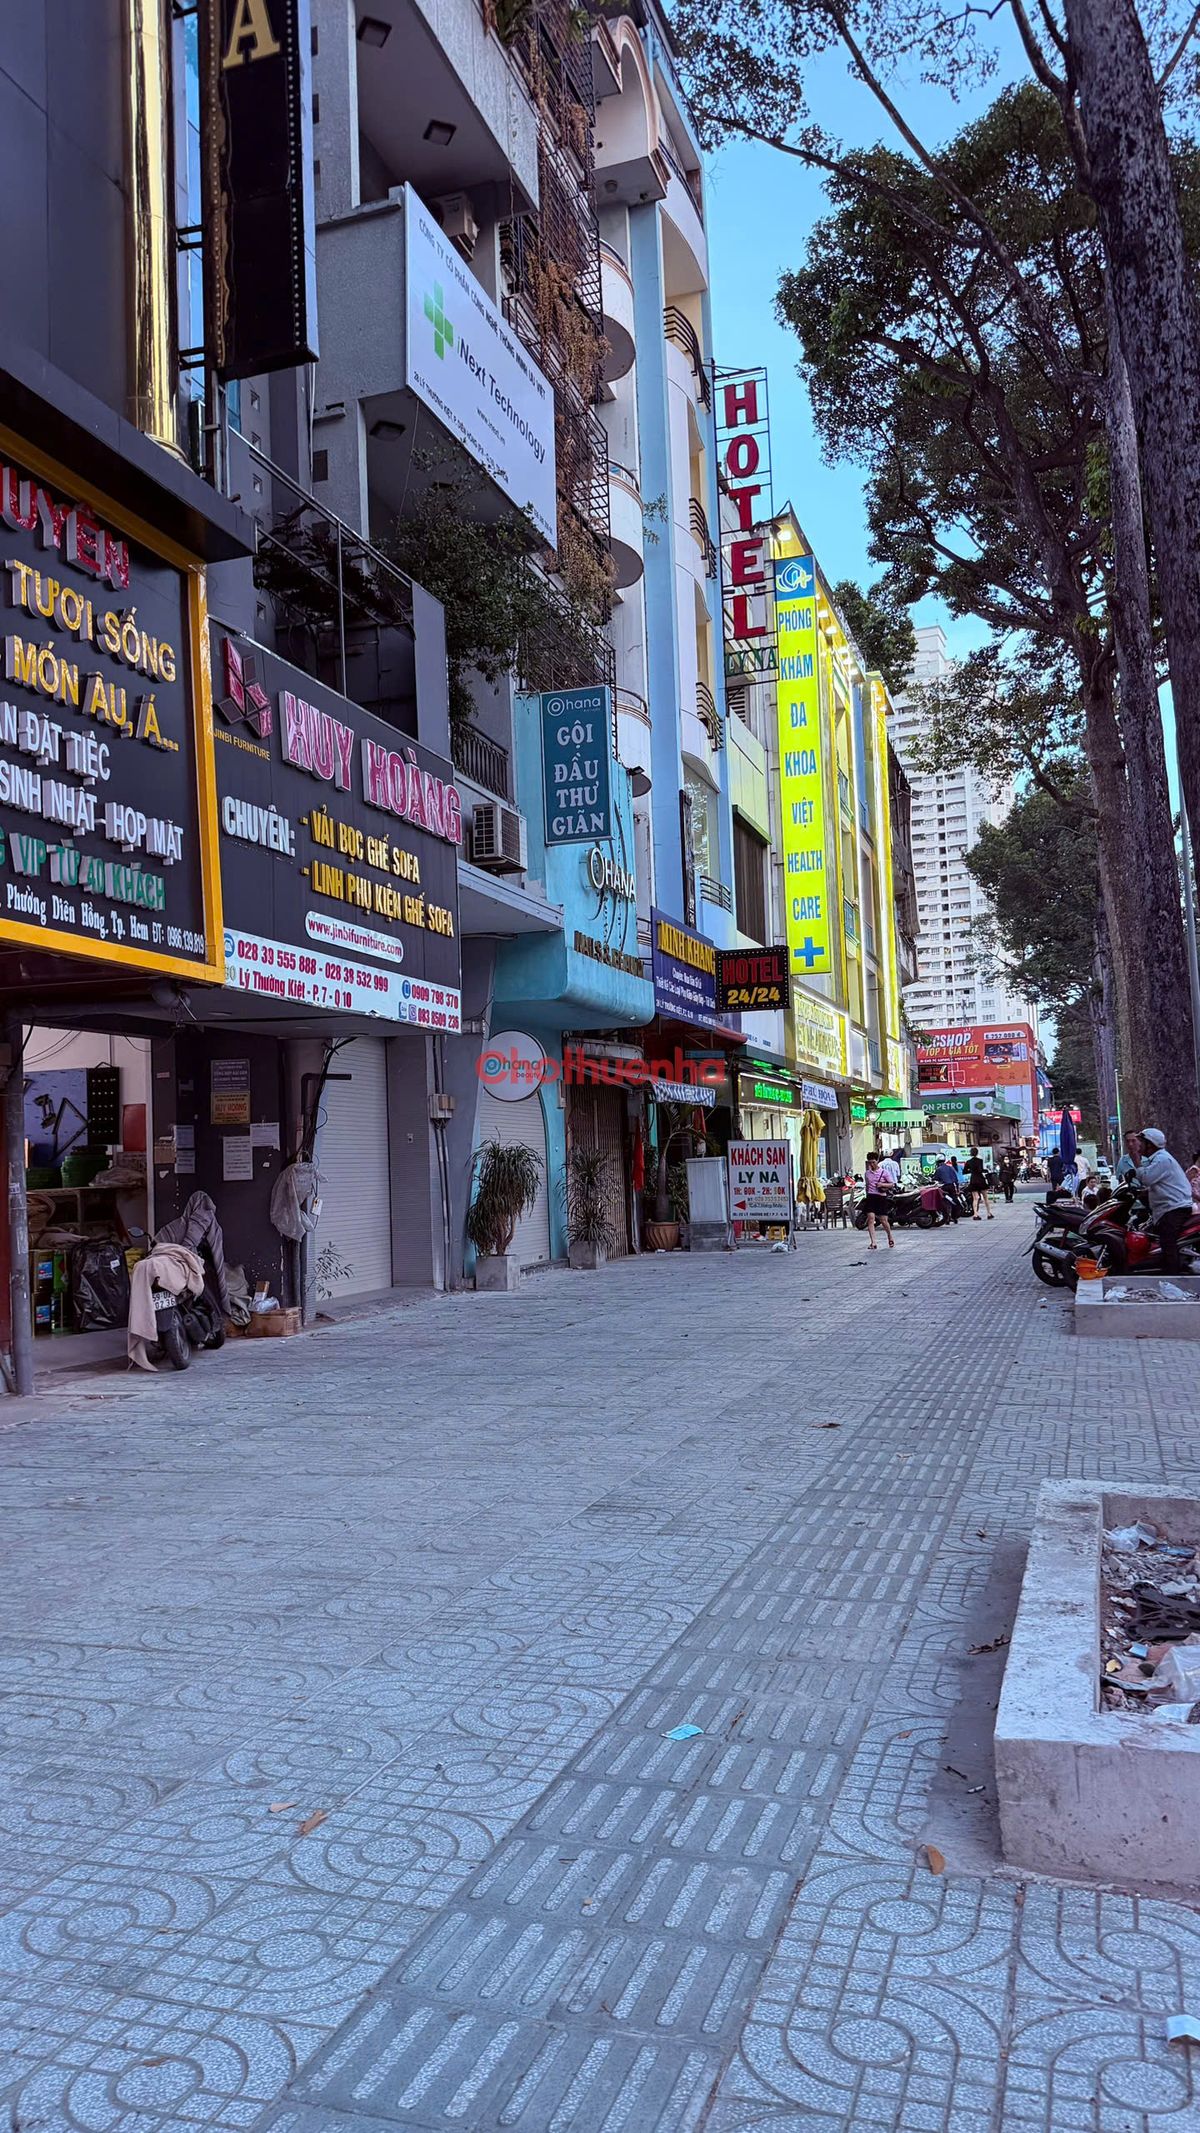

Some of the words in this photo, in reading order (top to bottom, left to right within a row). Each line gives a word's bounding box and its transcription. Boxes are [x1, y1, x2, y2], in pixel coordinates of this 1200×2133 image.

[436, 240, 444, 259] TY
[456, 335, 487, 389] iNext
[488, 372, 547, 465] Technology
[723, 379, 768, 640] HOTEL
[5, 558, 93, 642] TƯƠI
[97, 606, 177, 683] SỐNG
[778, 604, 812, 633] PHÒNG
[6, 634, 80, 708] MÓN
[780, 650, 814, 681] KHÁM
[790, 701, 807, 728] ĐA
[0, 700, 18, 746] N
[18, 710, 62, 767] ĐẶT
[62, 730, 112, 786] TIỆC
[232, 736, 271, 761] FURNITURE
[556, 719, 594, 749] GỘI
[279, 691, 354, 792] HUY
[361, 738, 463, 846] HOÀNG
[554, 752, 599, 783] ĐẦU
[785, 749, 817, 777] KHOA
[555, 780, 600, 809] THƯ
[0, 759, 43, 815] SINH
[43, 779, 98, 837] NHẬT
[106, 802, 148, 853] HỌP
[147, 819, 184, 866] MẶT
[222, 795, 296, 858] CHUYÊN:
[551, 809, 605, 837] GIÃN
[792, 796, 814, 829] VIỆT
[310, 804, 335, 849] VẢI
[337, 821, 364, 863] BỌC
[367, 833, 390, 873] GHẾ
[392, 846, 421, 885] SOFA
[9, 832, 47, 877] VIP
[47, 838, 80, 888] TỪ
[105, 862, 166, 912] KHÁCH
[787, 849, 823, 874] HEALTH
[6, 883, 47, 926] Phường
[52, 895, 76, 924] Diên
[130, 914, 149, 941] Hcm
[312, 859, 345, 900] LINH
[347, 873, 372, 915] PHỤ
[373, 882, 402, 923] KIỆN
[403, 891, 426, 929] GHẾ
[427, 903, 455, 938] SOFA
[793, 895, 822, 921] CARE
[307, 917, 403, 956] www.jinbifurniture.com
[656, 919, 686, 963] MINH
[686, 935, 716, 977] KHANG
[237, 940, 259, 961] 028
[261, 945, 274, 965] 39
[276, 949, 297, 971] 555
[298, 955, 317, 976] 888
[324, 961, 342, 982] 028
[356, 970, 373, 990] 532
[373, 974, 389, 993] 999
[722, 955, 784, 985] HOTEL
[239, 967, 250, 990] Lý
[252, 970, 285, 998] Thường
[287, 977, 306, 1001] Kiệt
[727, 986, 781, 1005] 24/24
[925, 1045, 941, 1056] TOP
[936, 1102, 964, 1111] PETRO
[731, 1143, 764, 1166] KHÁCH
[766, 1146, 786, 1169] SẠN
[738, 1171, 755, 1184] LY
[760, 1171, 780, 1184] NA
